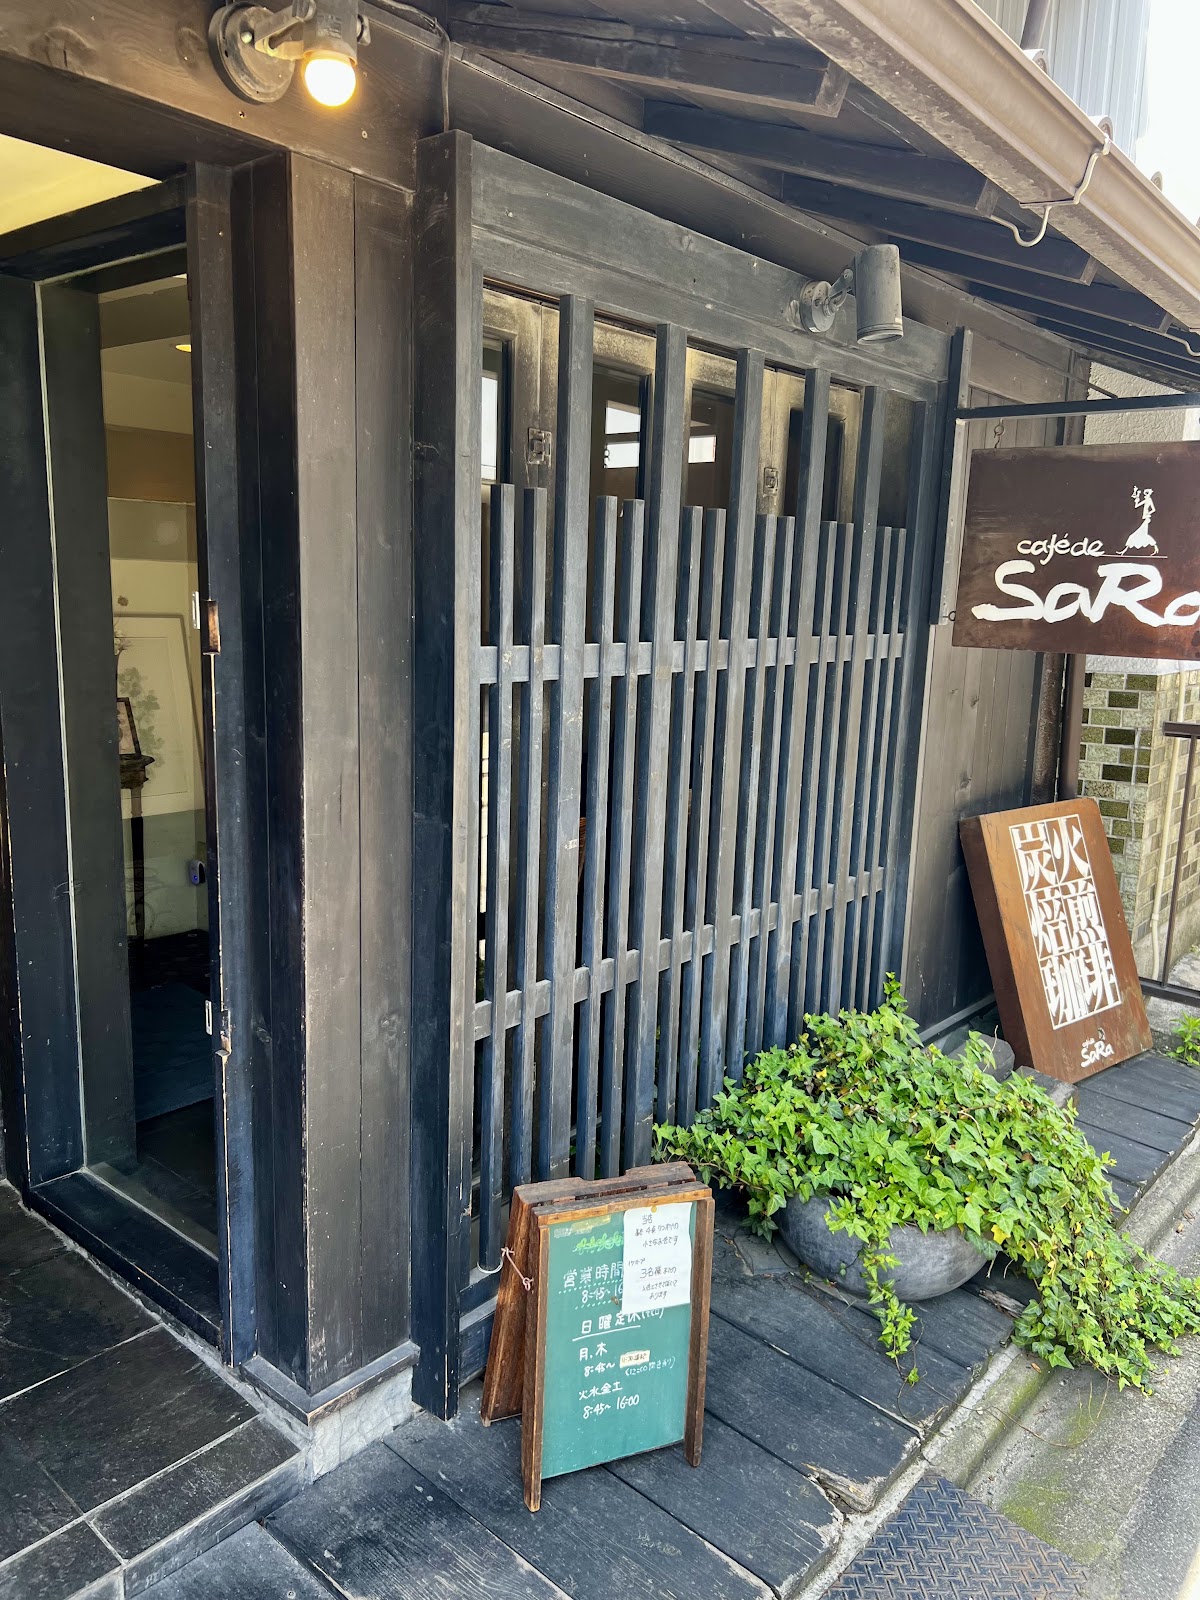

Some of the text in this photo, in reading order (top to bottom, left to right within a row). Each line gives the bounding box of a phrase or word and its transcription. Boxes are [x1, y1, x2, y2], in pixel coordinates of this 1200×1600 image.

[1016, 532, 1106, 565] café de
[1011, 818, 1091, 893] 炭火
[1029, 879, 1106, 960] 焙煎
[1041, 941, 1116, 1024] 珈琲
[1080, 1041, 1115, 1068] SaRa
[578, 1381, 623, 1401] 火水金土
[616, 1394, 640, 1410] 16:00
